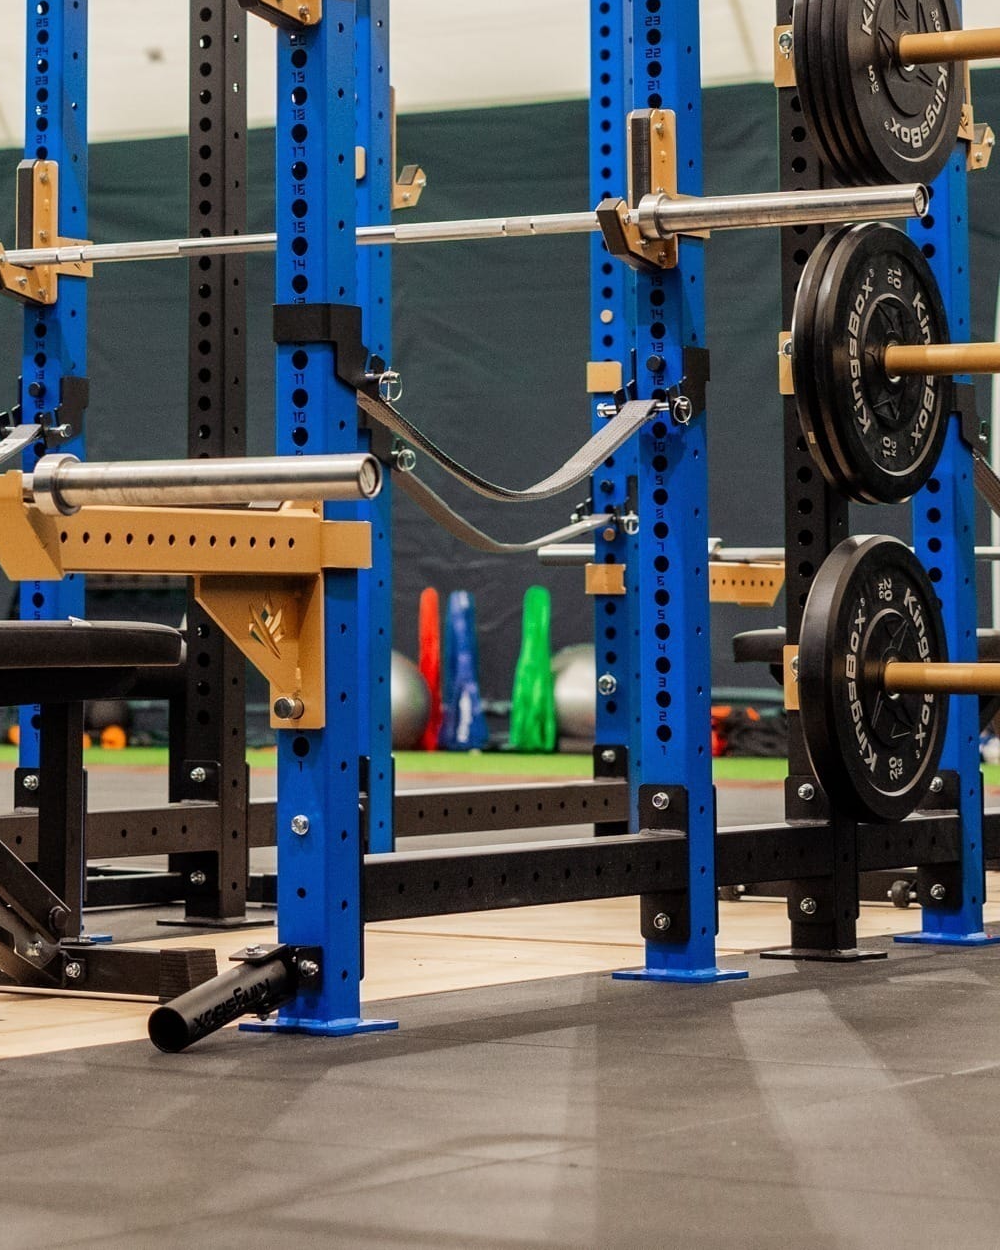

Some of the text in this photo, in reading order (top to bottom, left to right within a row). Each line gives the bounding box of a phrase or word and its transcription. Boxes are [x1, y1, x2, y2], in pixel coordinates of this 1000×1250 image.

[890, 66, 948, 148] KingsBox
[893, 268, 902, 290] 10
[848, 277, 874, 435] KingsBox
[881, 436, 891, 458] 10
[883, 577, 892, 601] 20
[846, 608, 879, 772] KingsBox
[889, 756, 898, 781] 20
